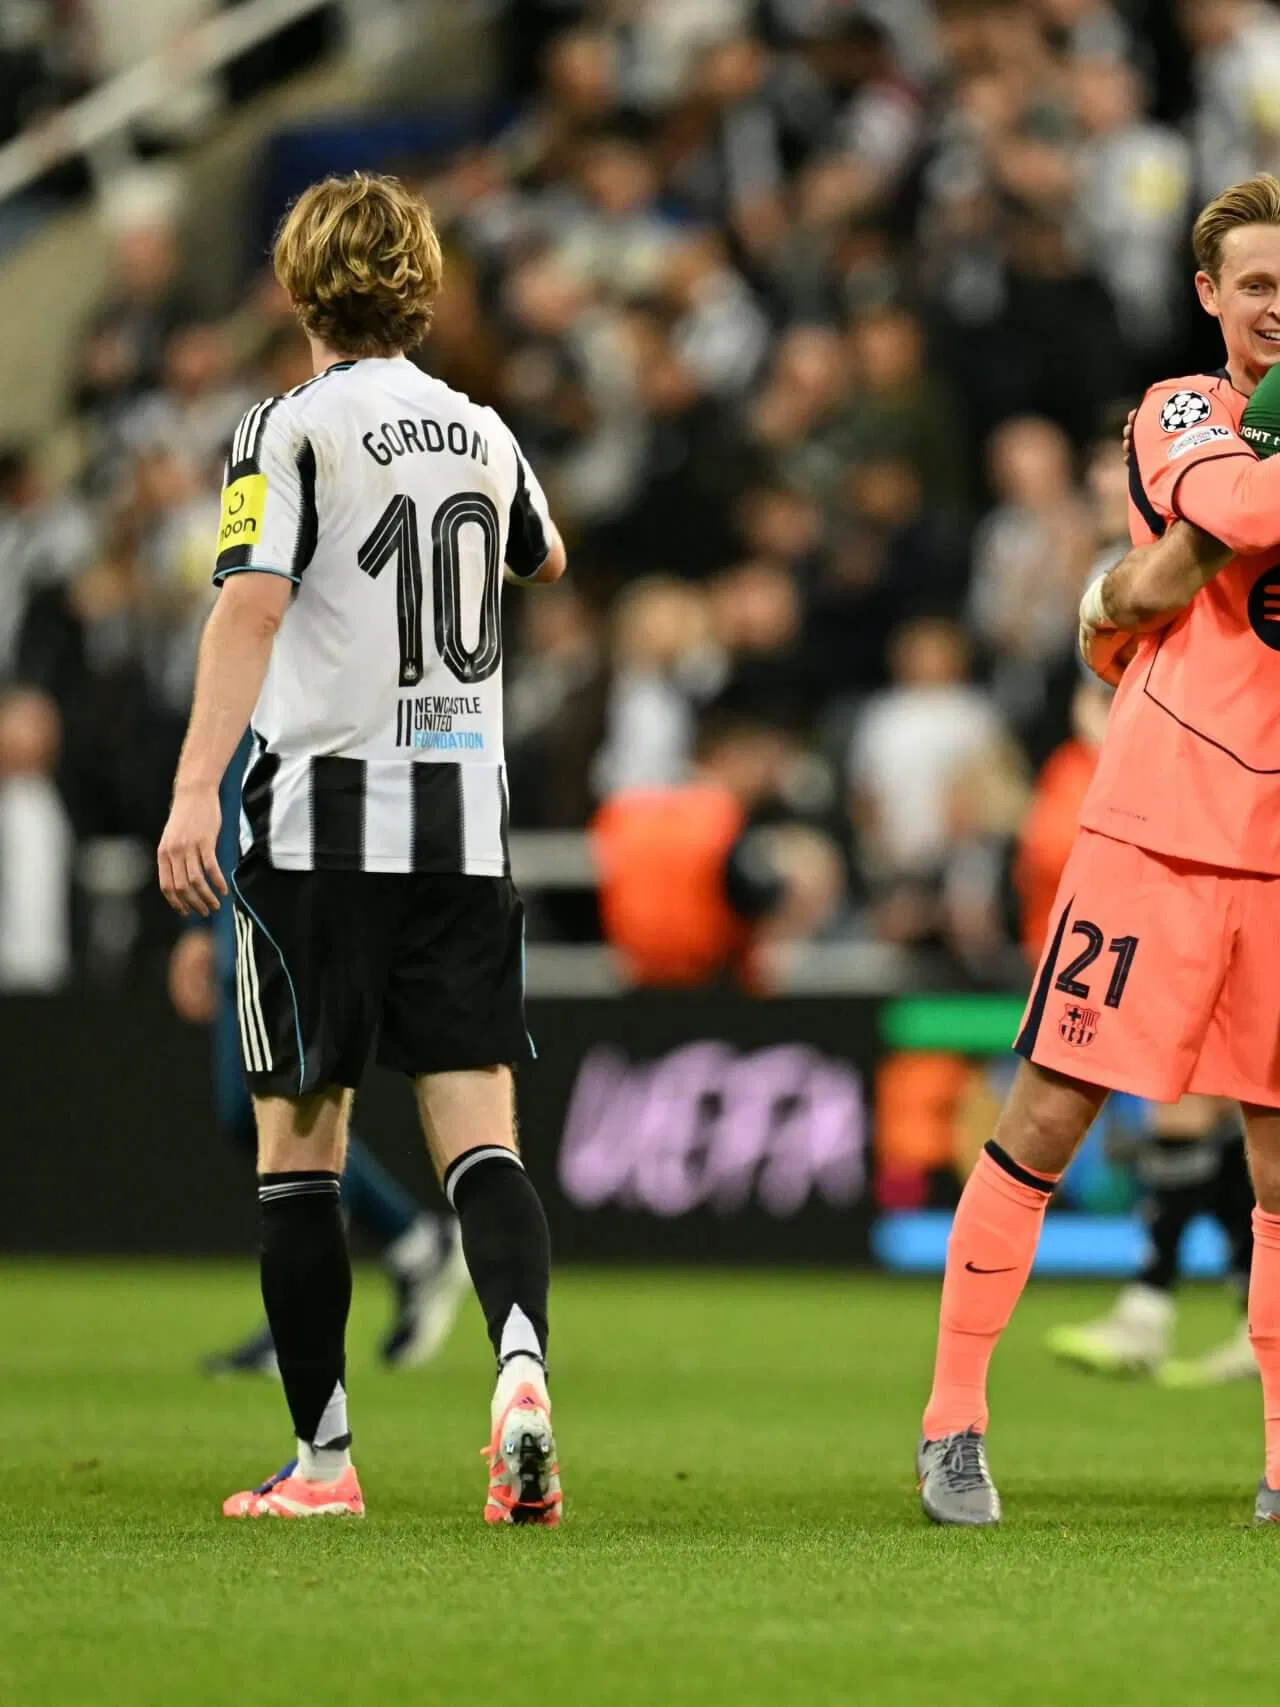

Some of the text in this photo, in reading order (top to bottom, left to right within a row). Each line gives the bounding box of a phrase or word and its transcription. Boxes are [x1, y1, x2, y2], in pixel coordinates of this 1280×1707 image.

[362, 419, 489, 466] GORDON
[357, 491, 502, 687] 10
[414, 695, 483, 715] NEWCASTLE
[414, 712, 453, 733] UNITED
[414, 731, 485, 750] FOUNDATION
[1055, 920, 1140, 1009] 21
